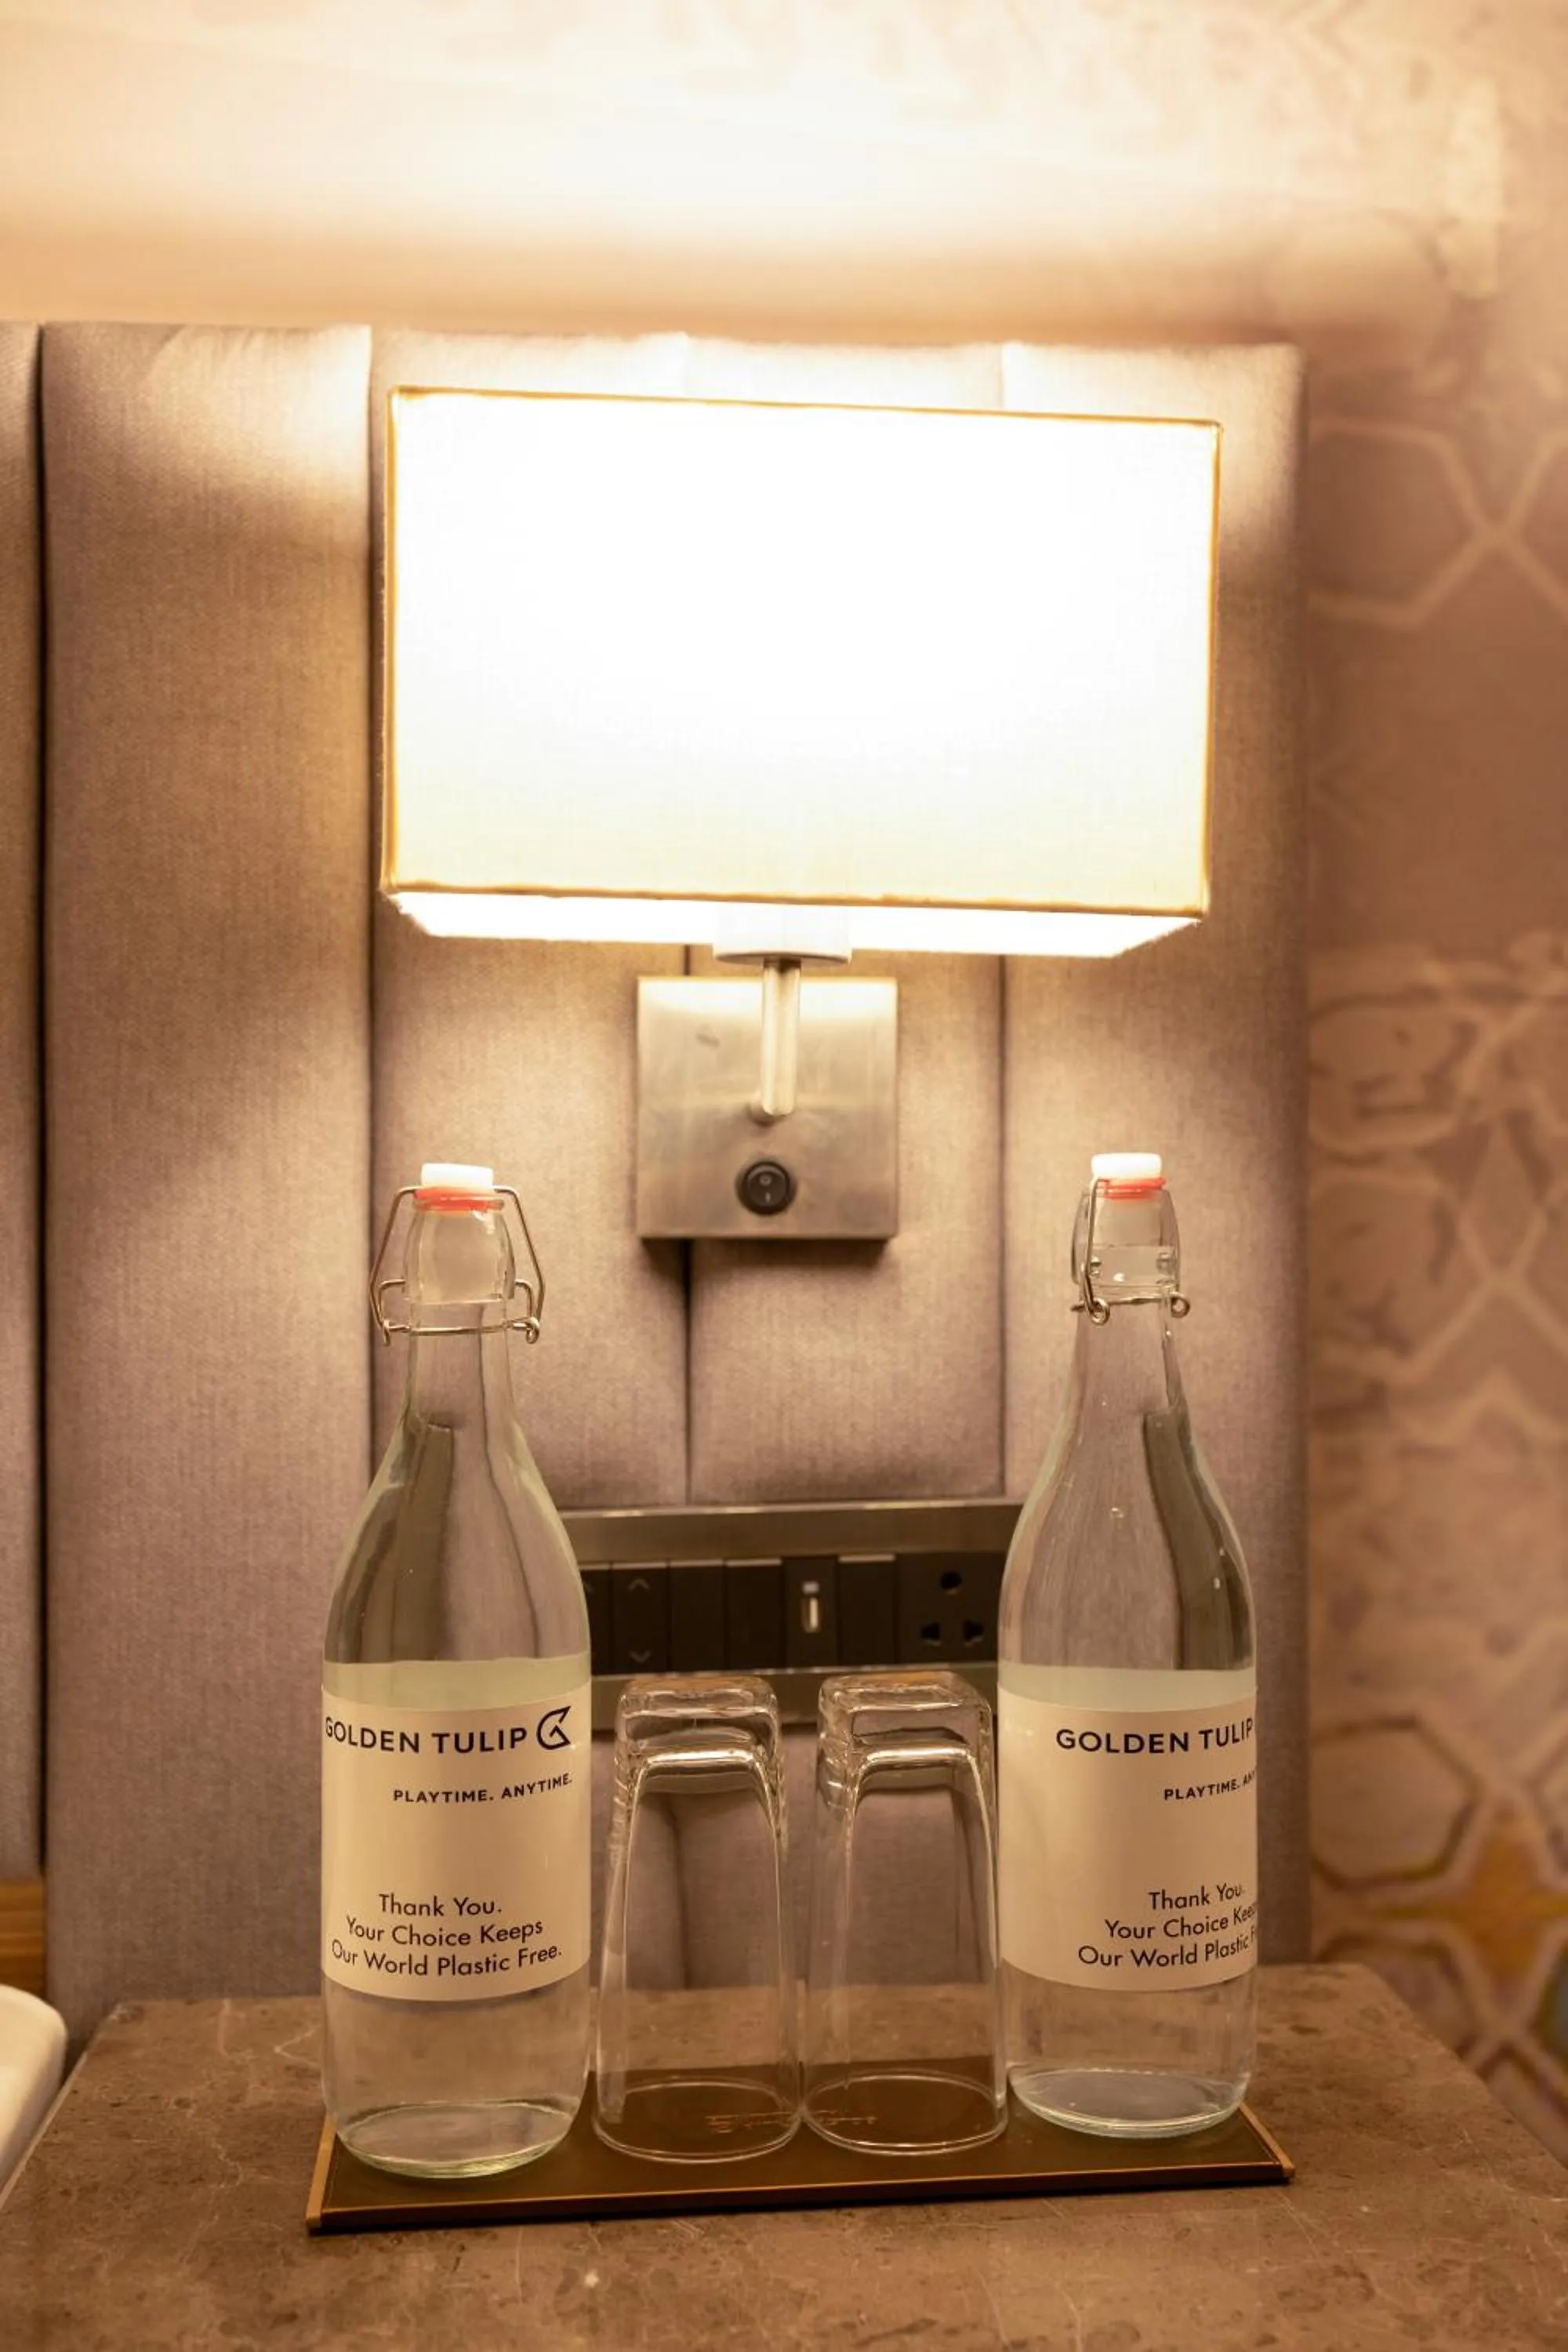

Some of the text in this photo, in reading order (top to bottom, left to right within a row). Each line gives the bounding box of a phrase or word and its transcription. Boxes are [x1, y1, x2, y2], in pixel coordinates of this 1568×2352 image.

[325, 1716, 419, 1754] GOLDEN
[431, 1727, 527, 1754] TULIP
[1056, 1717, 1254, 1754] GOLDEN TULIP
[394, 1773, 572, 1803] PLAYTIME. ANYTIME.
[1164, 1779, 1240, 1801] PLAYTIME.
[379, 1892, 502, 1916] Thank You.
[1149, 1886, 1210, 1911] Thank
[347, 1915, 543, 1947] Your Choice Keeps
[1105, 1919, 1156, 1939] Your
[1163, 1917, 1229, 1938] Choice
[1233, 1905, 1255, 1926] Kee
[332, 1939, 562, 1976] Our World Plastic Free.
[1078, 1945, 1123, 1966] Our
[1131, 1944, 1198, 1968] World
[1205, 1933, 1249, 1962] Plastic
